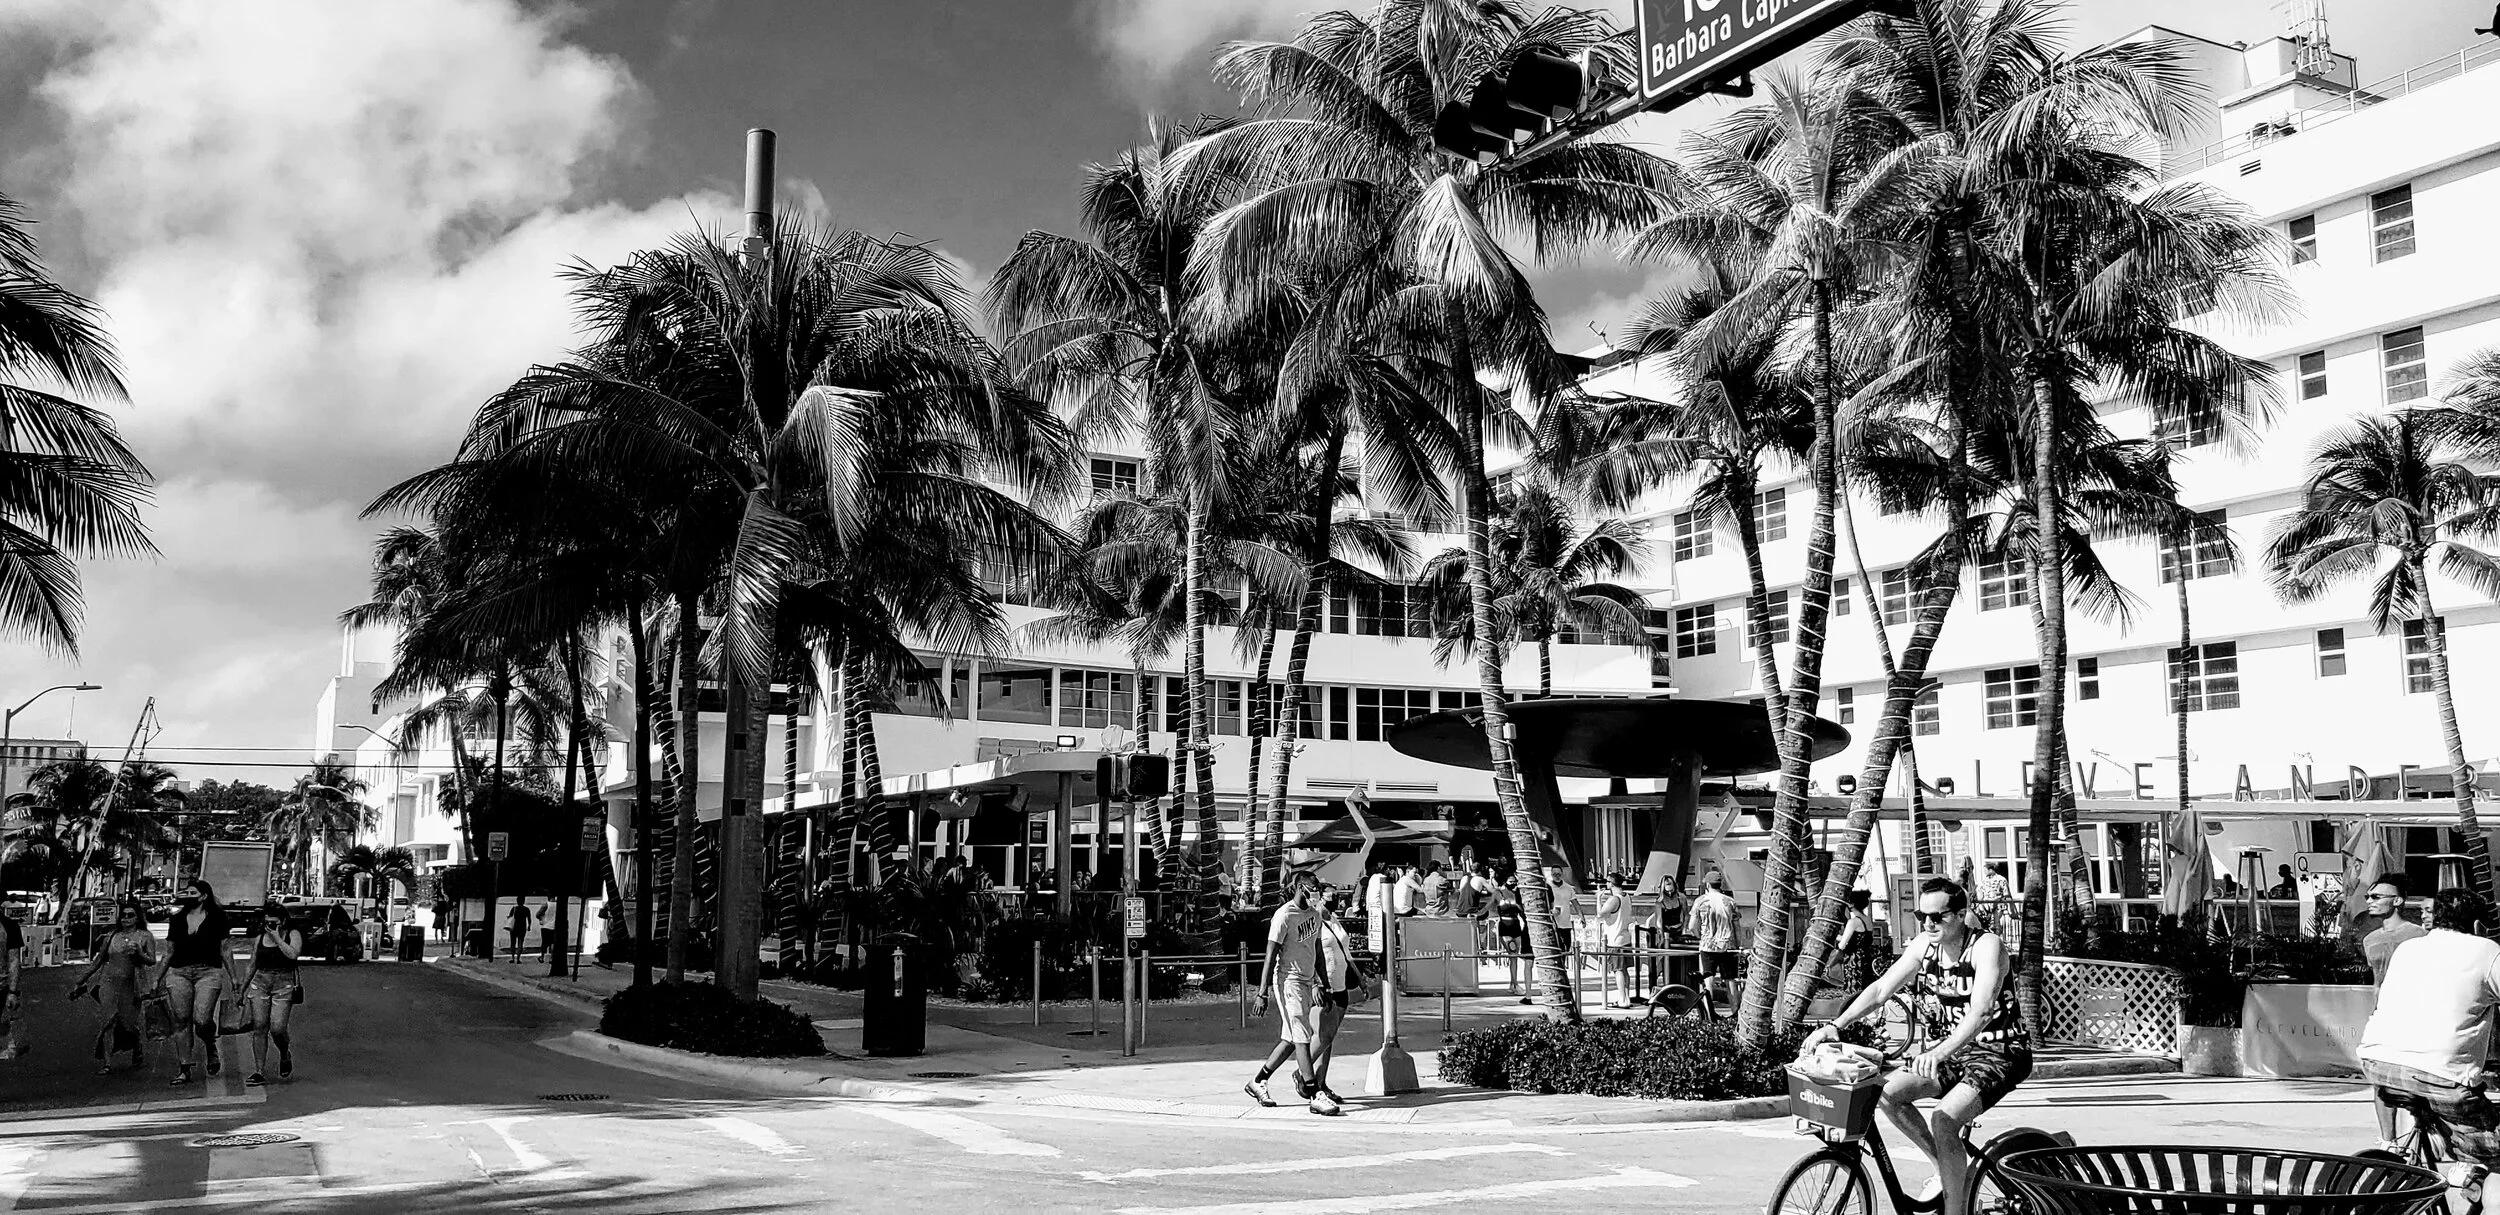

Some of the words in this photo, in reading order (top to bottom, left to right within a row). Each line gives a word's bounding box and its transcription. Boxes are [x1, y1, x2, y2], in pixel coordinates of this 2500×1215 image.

[1652, 13, 1731, 78] Barbara
[1741, 0, 1799, 29] Cap
[1918, 758, 2489, 802] LEVEANDER
[1298, 916, 1317, 942] NIKE
